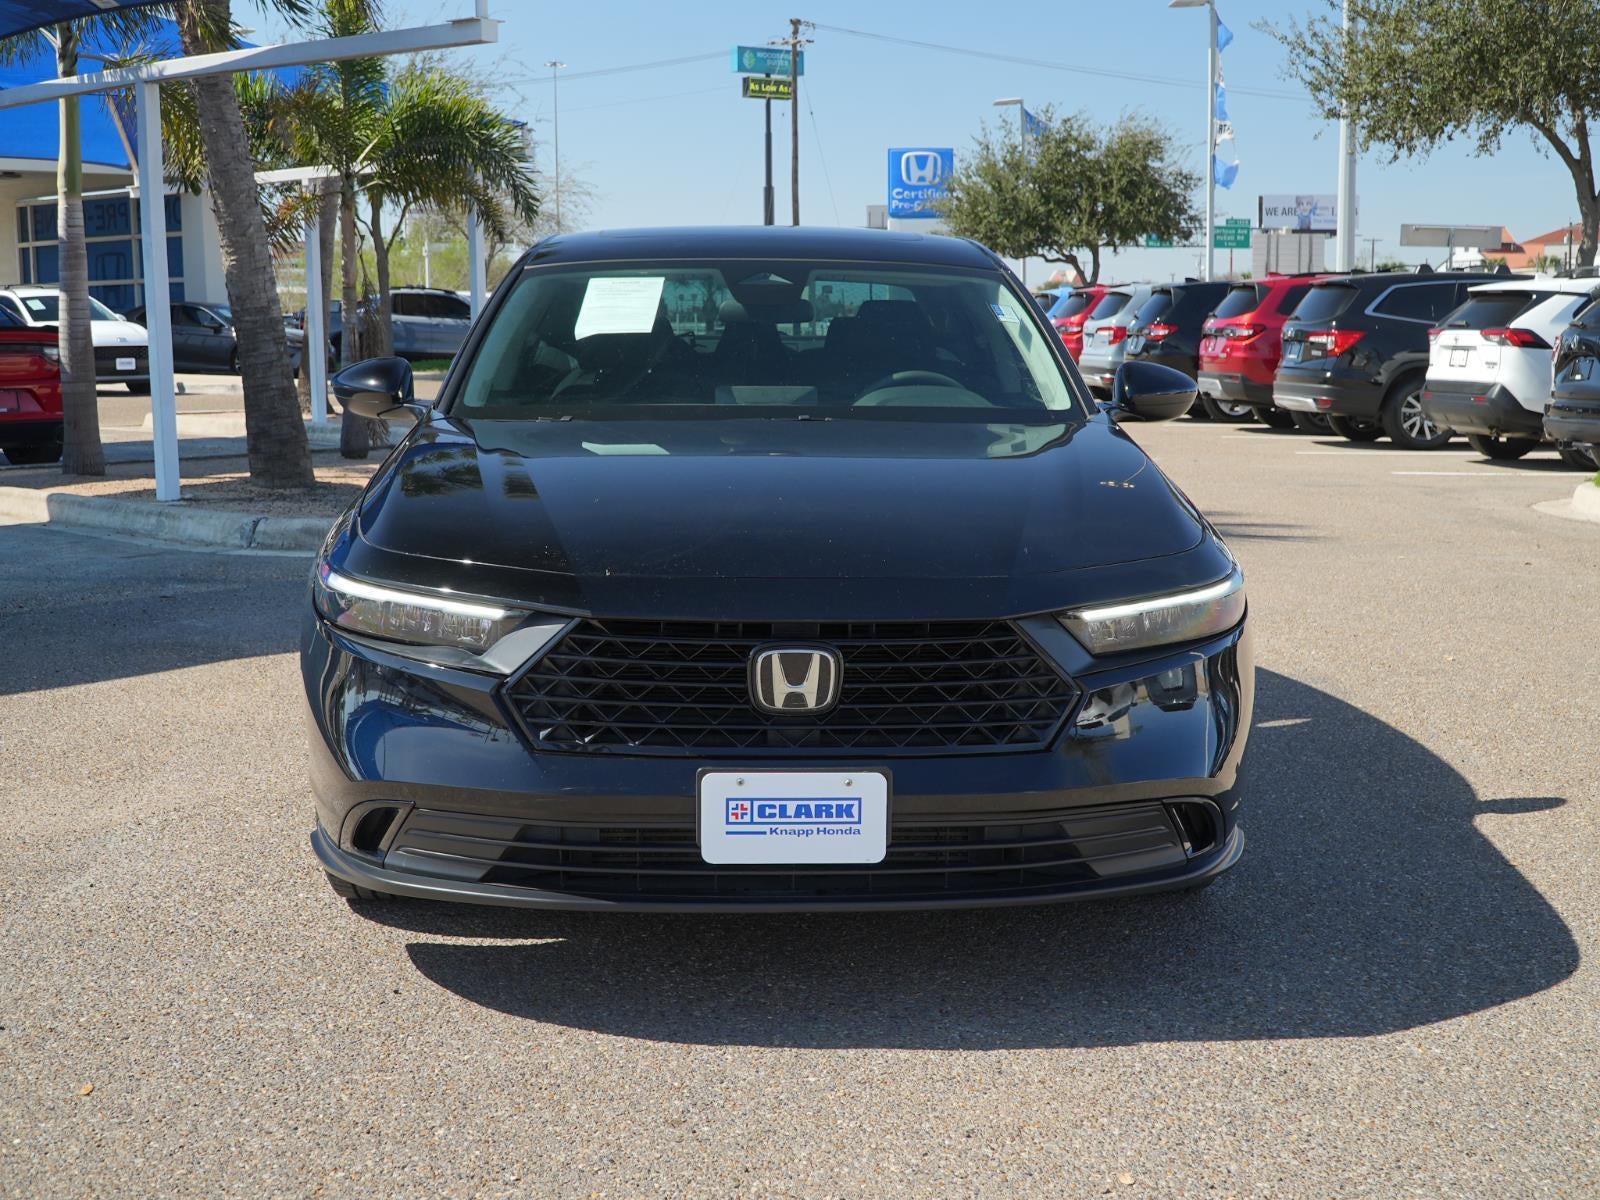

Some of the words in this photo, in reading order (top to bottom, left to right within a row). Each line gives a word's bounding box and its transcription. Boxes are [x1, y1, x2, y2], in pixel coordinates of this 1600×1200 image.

[761, 83, 777, 92] Low
[1265, 206, 1279, 217] WE
[757, 803, 856, 819] CLARK
[769, 827, 814, 838] Knapp
[816, 826, 861, 836] Honda
